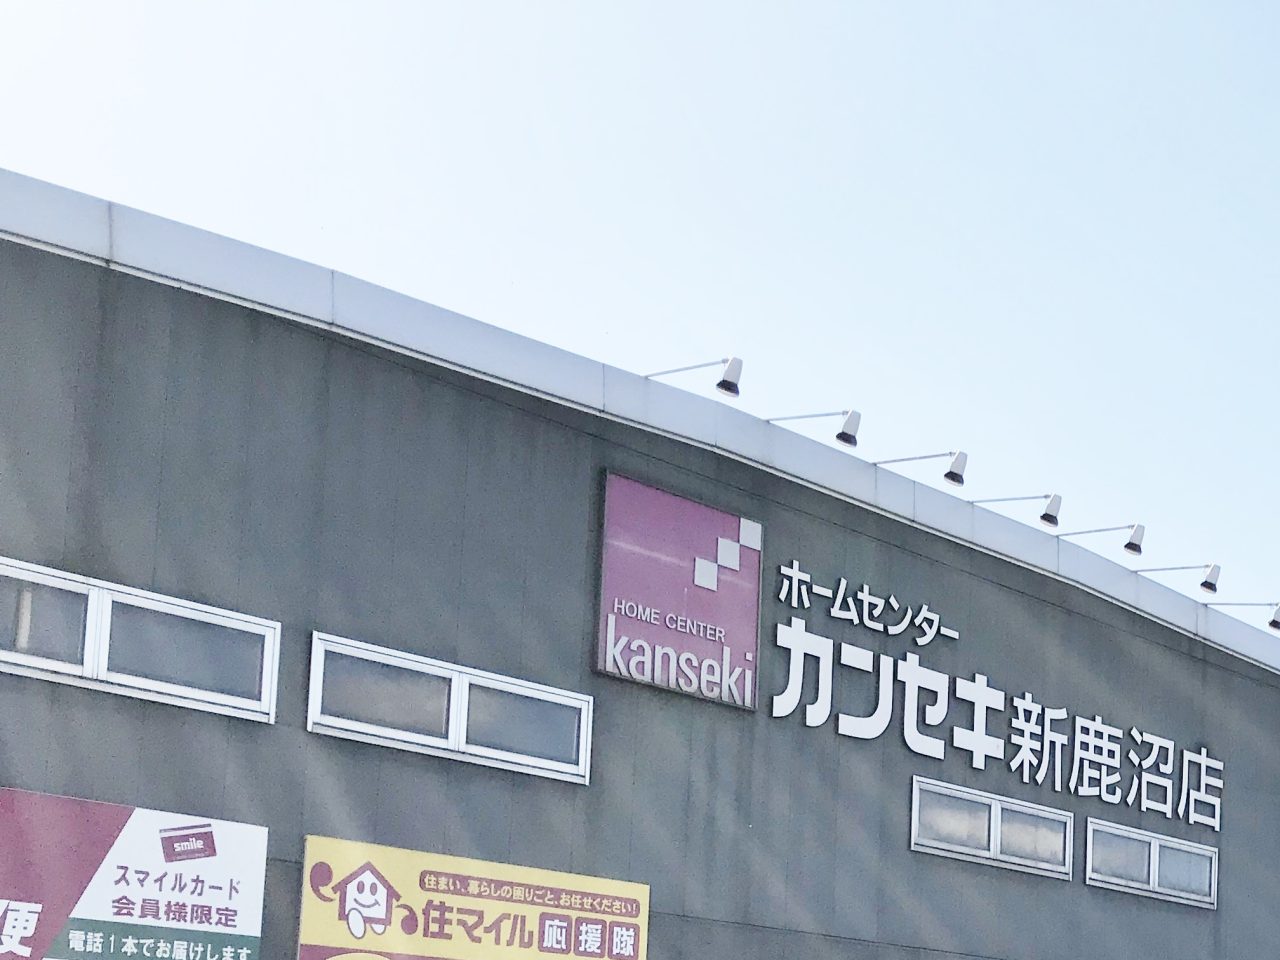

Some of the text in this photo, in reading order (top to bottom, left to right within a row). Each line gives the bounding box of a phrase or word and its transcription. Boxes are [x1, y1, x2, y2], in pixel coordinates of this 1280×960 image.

[614, 598, 726, 643] HOME CENTER
[778, 559, 960, 647] ホームセンター
[605, 613, 753, 708] kanseki
[772, 617, 1225, 832] カンセキ新鹿沼店
[173, 837, 205, 852] smile
[114, 865, 241, 900] スマイルカード
[112, 895, 239, 928] 会員様限定
[422, 899, 636, 958] 住マイル応援隊
